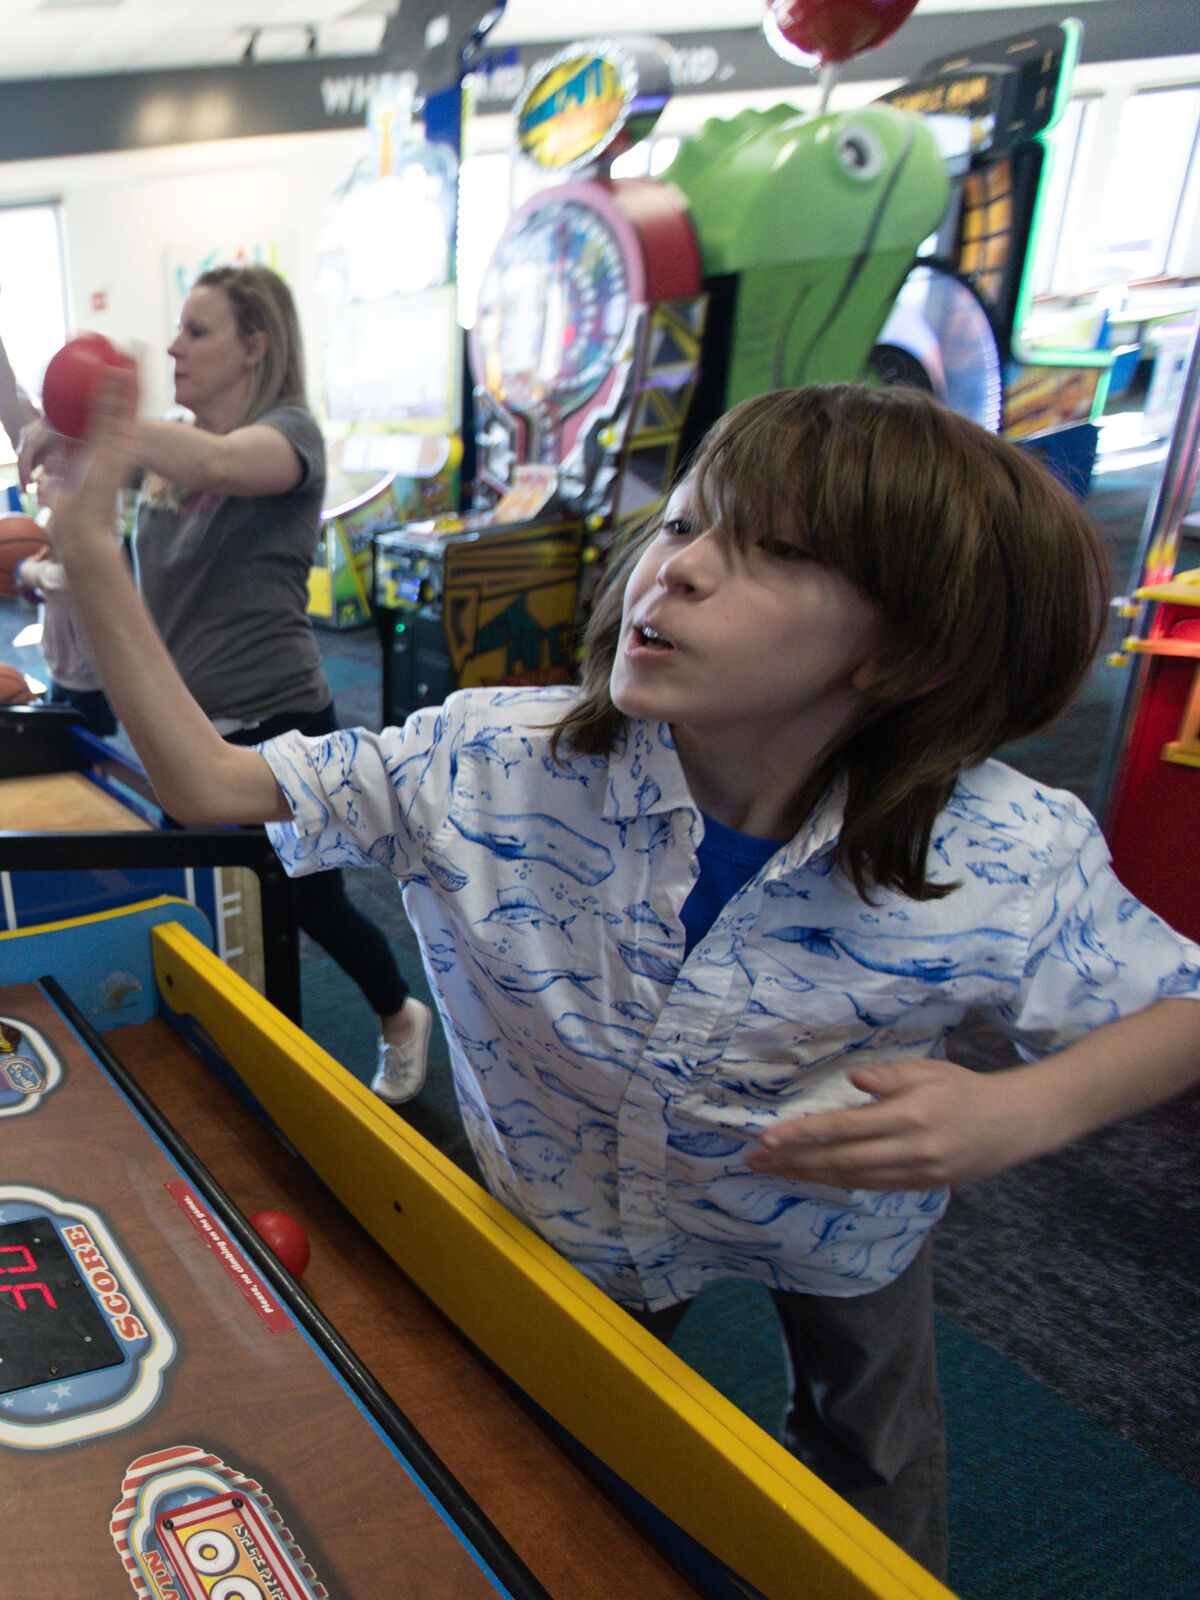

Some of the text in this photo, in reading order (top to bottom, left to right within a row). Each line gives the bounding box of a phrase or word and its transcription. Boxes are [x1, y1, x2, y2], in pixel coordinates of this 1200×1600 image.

[200, 1219, 213, 1232] the
[209, 1231, 221, 1241] on
[216, 1241, 245, 1273] climbing
[61, 1224, 148, 1341] SCORE
[241, 1273, 253, 1285] no
[251, 1284, 275, 1314] Please,
